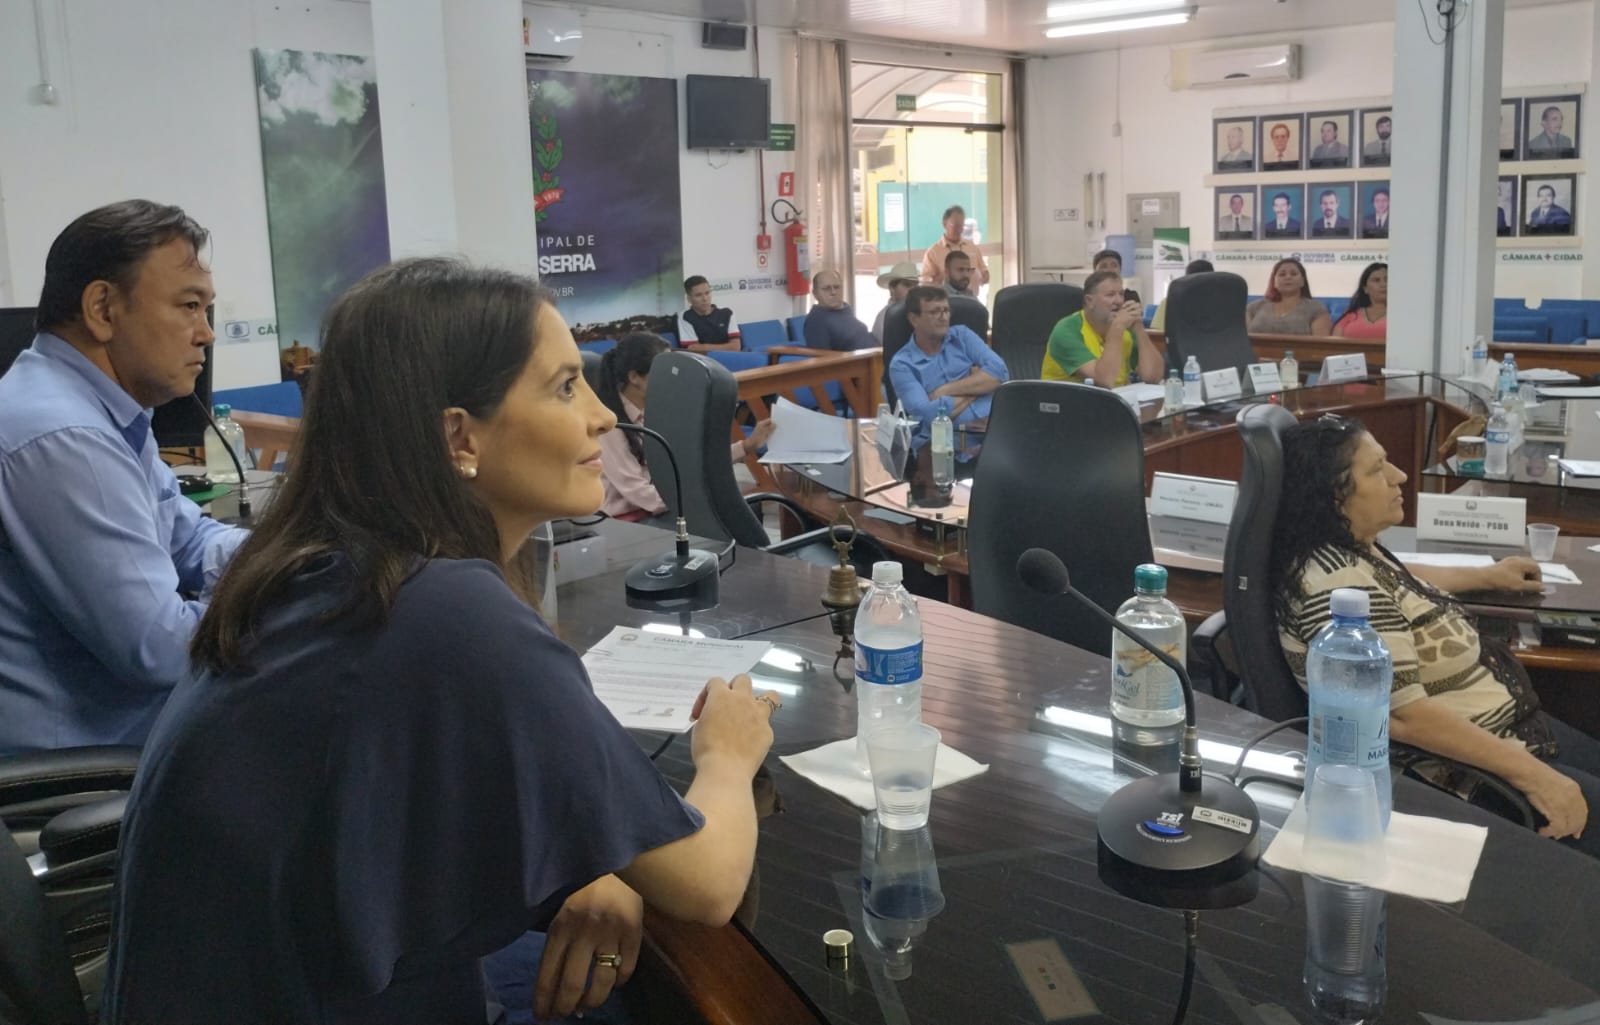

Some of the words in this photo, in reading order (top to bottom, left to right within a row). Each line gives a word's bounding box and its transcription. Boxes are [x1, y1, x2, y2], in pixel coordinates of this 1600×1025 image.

[540, 236, 572, 249] IPAL
[577, 234, 596, 246] DE
[1215, 253, 1247, 261] CÂMARA
[1340, 253, 1377, 261] CÂMARA
[1502, 252, 1543, 261] CÂMARA
[539, 253, 597, 274] SERRA
